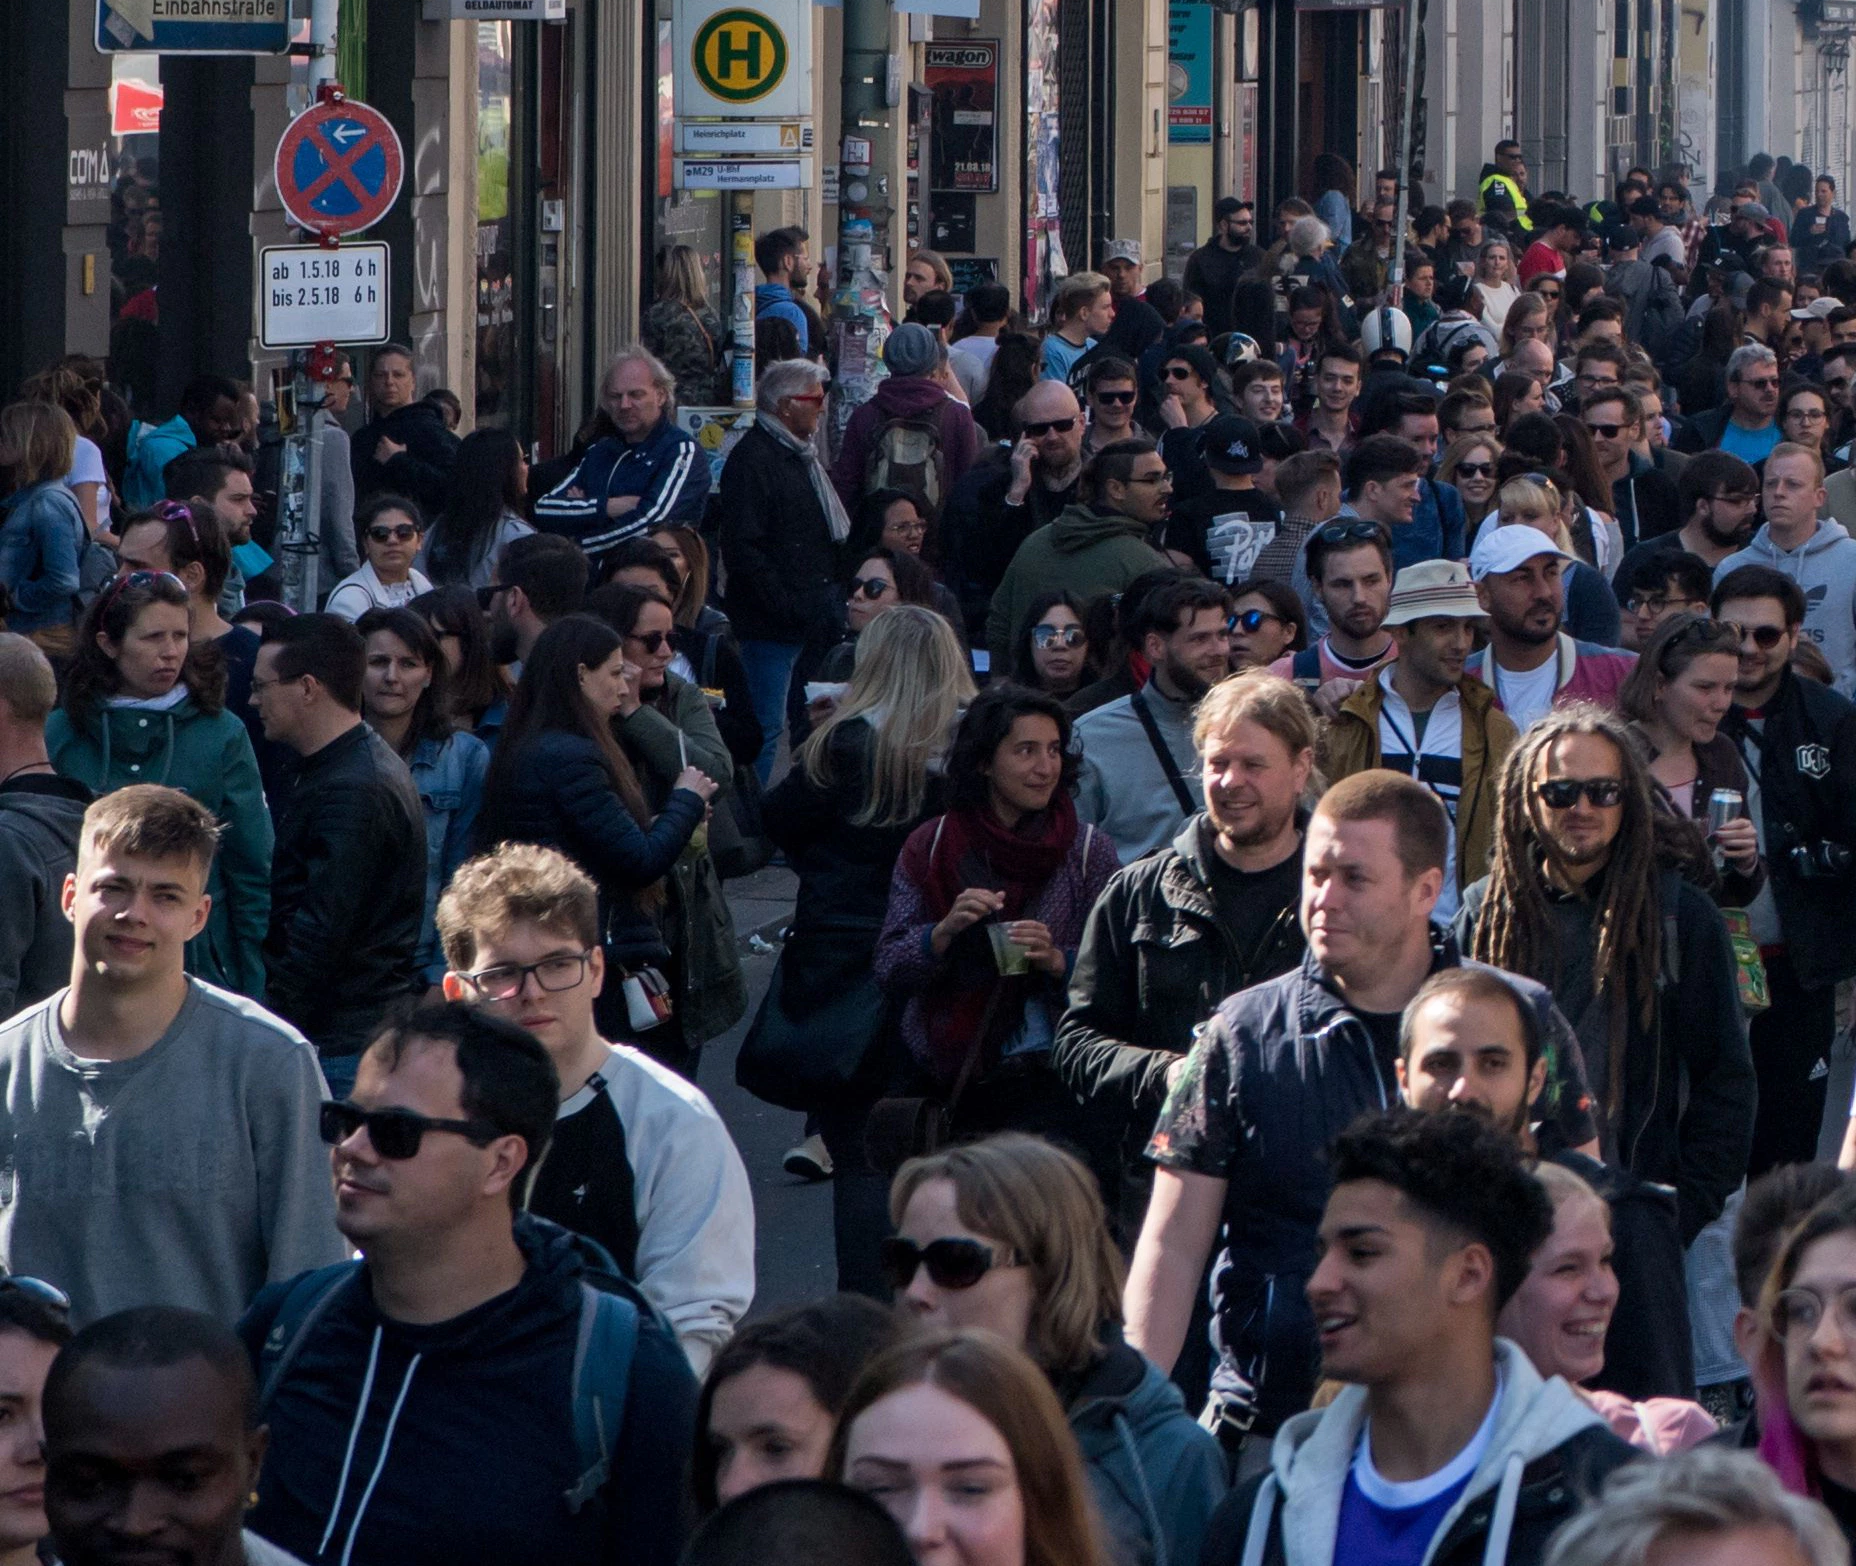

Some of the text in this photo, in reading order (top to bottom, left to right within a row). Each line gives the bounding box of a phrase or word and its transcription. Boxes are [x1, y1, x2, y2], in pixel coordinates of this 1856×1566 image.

[465, 0, 534, 10] GELDAUTOMAT
[717, 31, 761, 80] H
[693, 166, 714, 176] M29
[272, 259, 376, 280] ab 1.5.18 6 h
[272, 285, 376, 307] bis 2.5.18 6 h
